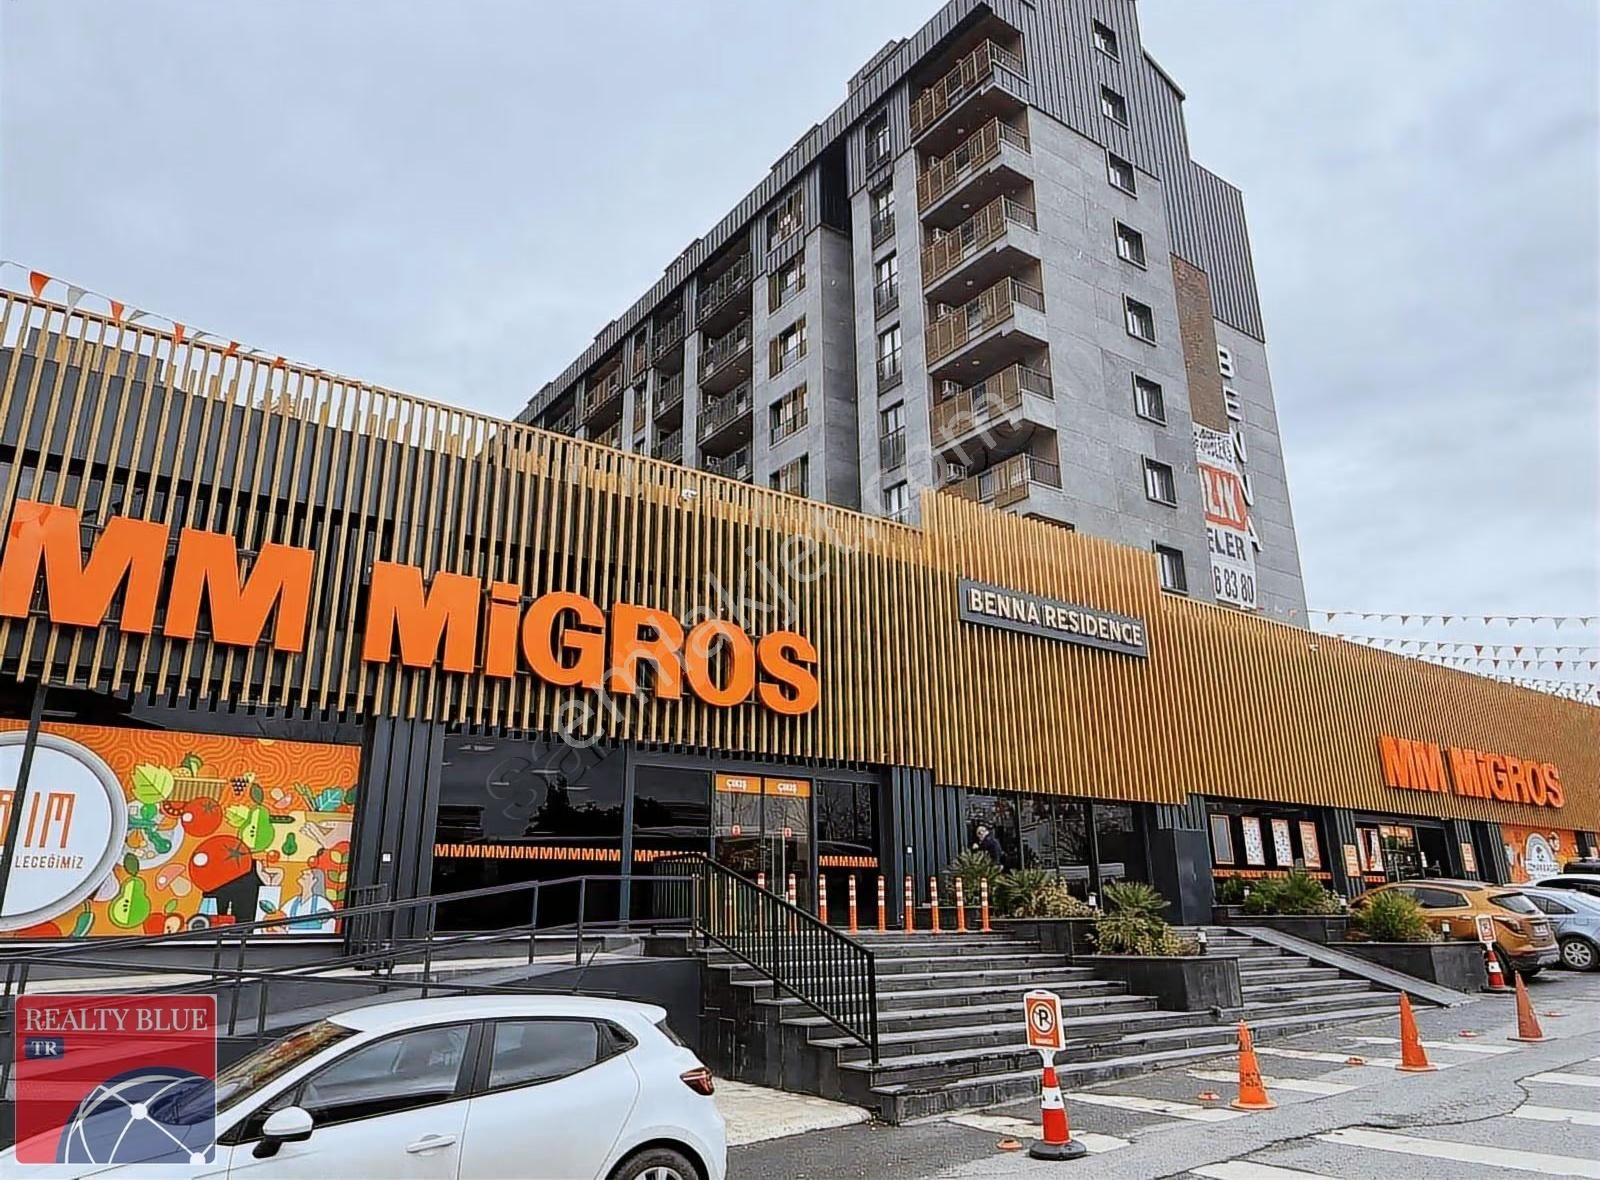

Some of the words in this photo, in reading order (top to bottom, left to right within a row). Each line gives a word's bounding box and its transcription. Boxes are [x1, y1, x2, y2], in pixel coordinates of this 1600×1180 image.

[0, 499, 315, 653] MM
[969, 587, 1040, 626] BENNA
[1043, 604, 1143, 647] RESIDENCE
[1379, 734, 1449, 793] MM
